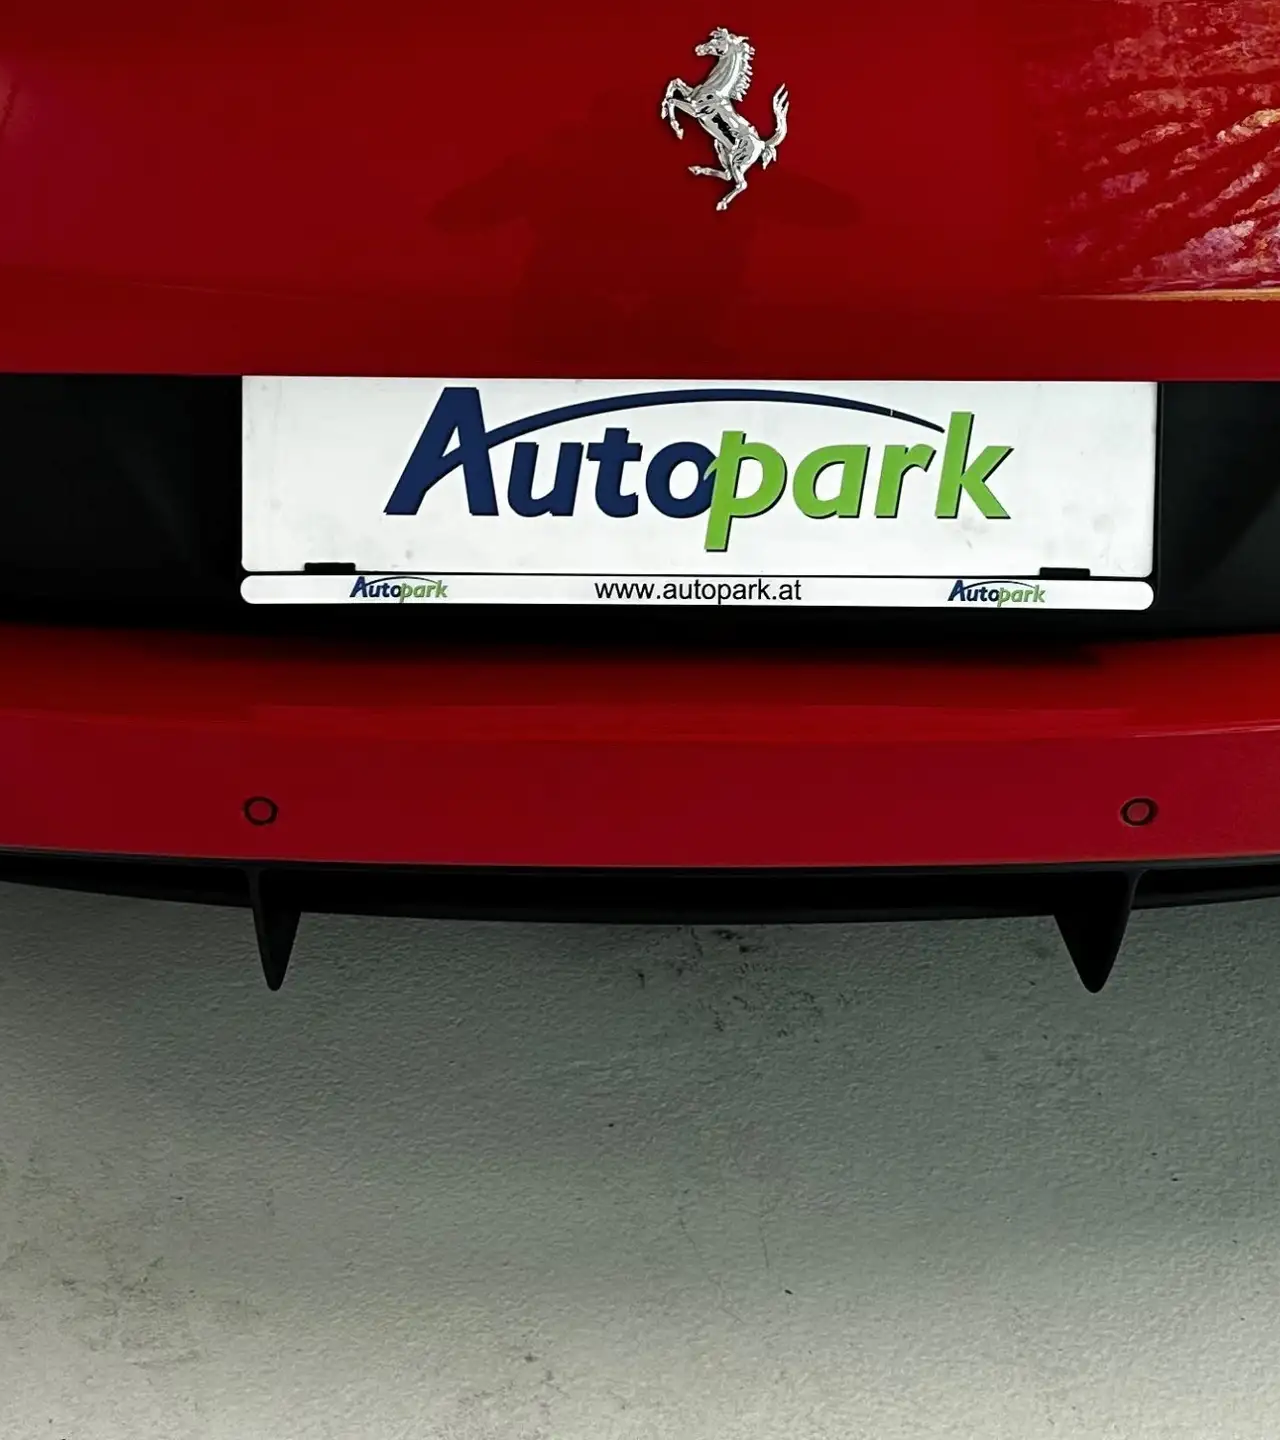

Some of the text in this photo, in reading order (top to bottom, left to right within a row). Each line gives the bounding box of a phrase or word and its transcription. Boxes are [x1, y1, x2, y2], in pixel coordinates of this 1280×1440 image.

[383, 387, 1014, 552] Autopark
[349, 576, 448, 603] Autopark
[594, 578, 802, 605] www.autopark.at
[947, 579, 1046, 607] Autopark
